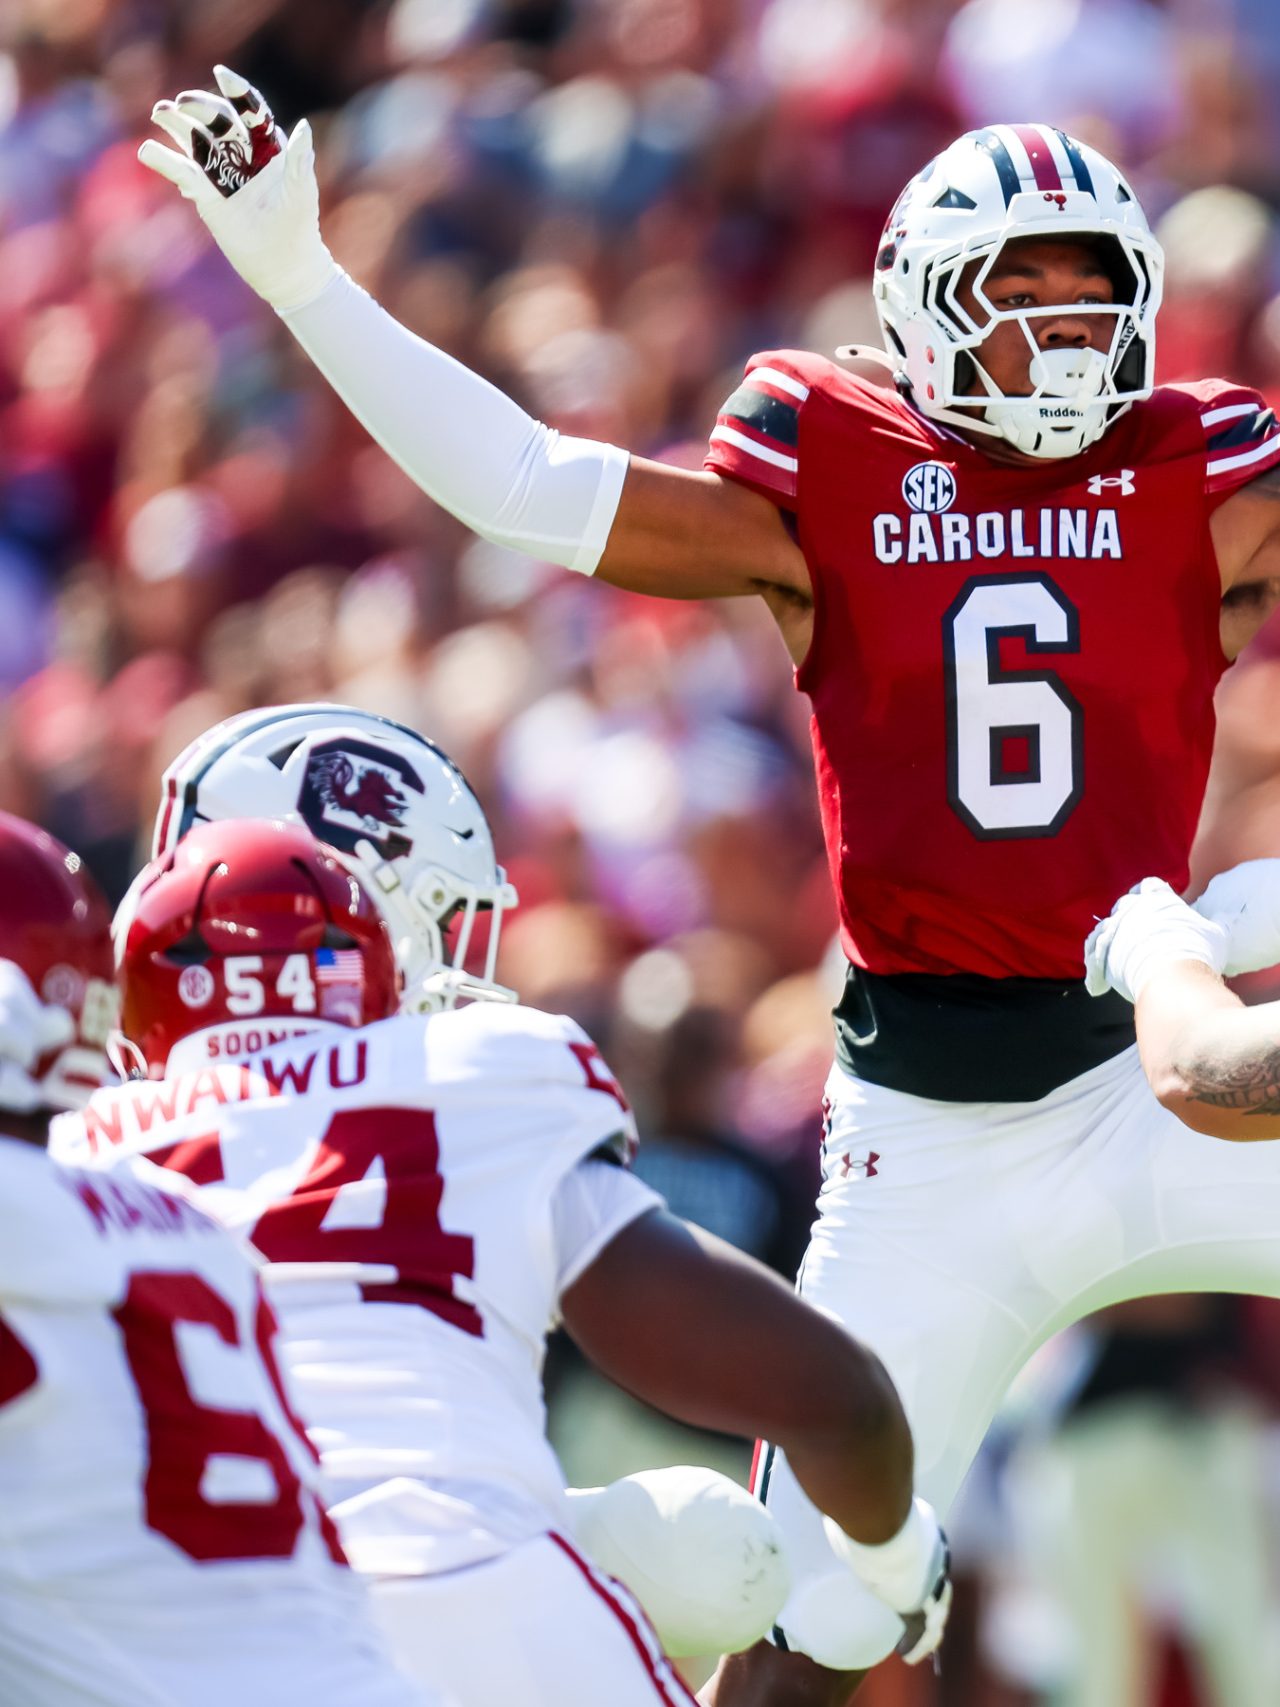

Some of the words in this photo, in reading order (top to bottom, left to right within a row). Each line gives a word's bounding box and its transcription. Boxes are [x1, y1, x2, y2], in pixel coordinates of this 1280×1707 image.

[905, 466, 953, 508] SEC
[873, 507, 1123, 564] CAROLINA
[943, 572, 1084, 841] 6
[224, 955, 317, 1014] 54
[83, 1040, 368, 1154] NWAIWU
[110, 1268, 350, 1566] 6
